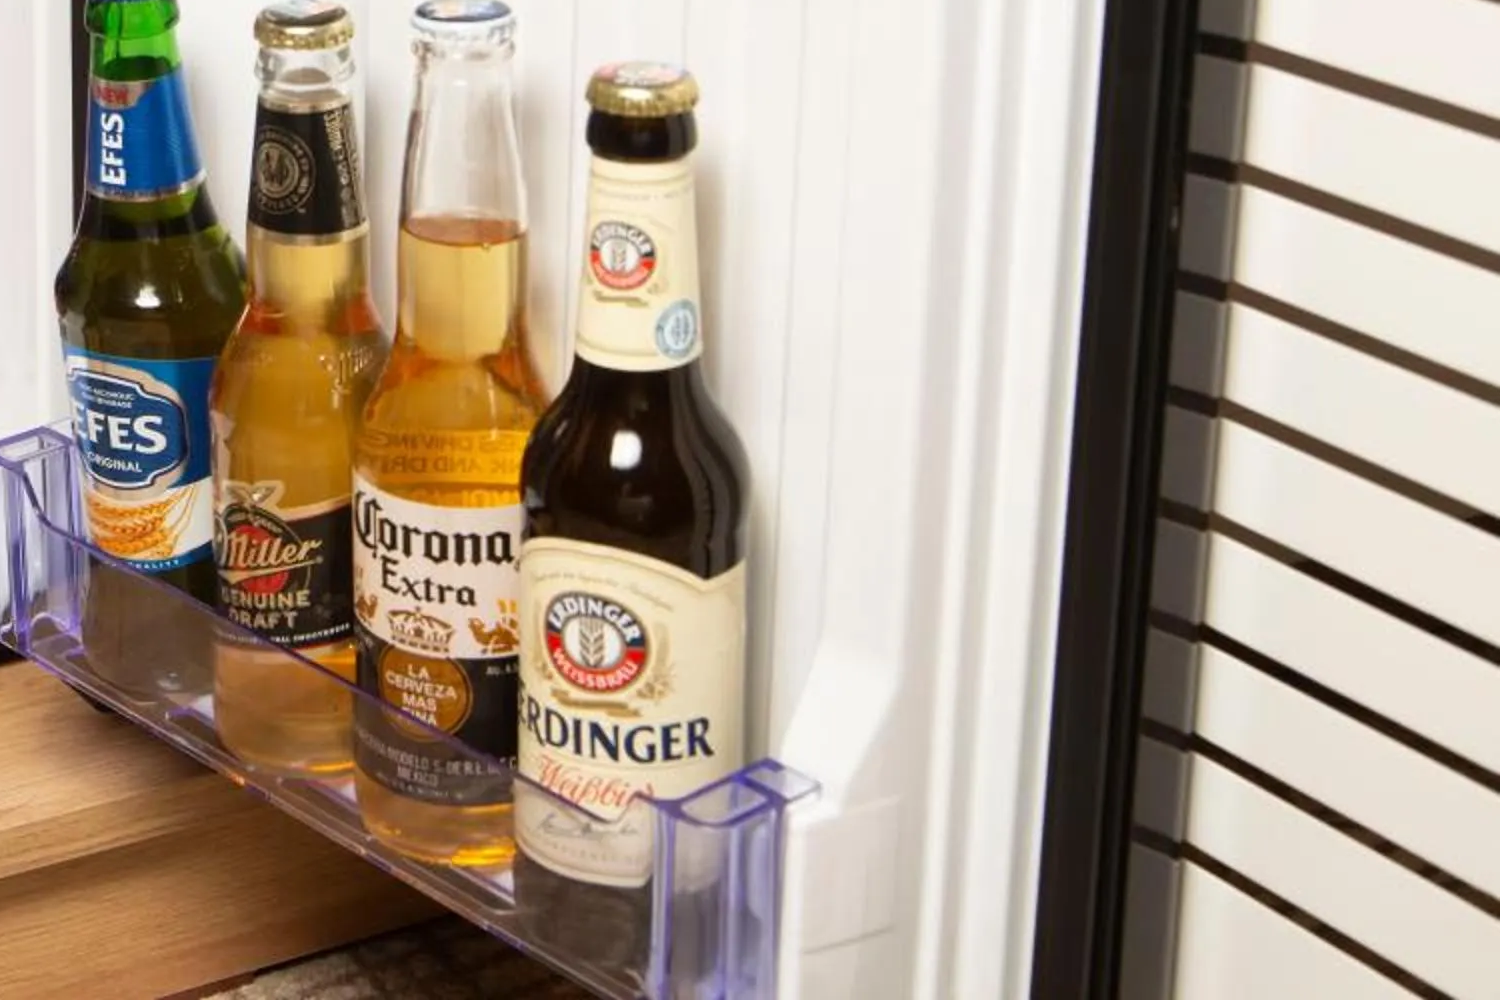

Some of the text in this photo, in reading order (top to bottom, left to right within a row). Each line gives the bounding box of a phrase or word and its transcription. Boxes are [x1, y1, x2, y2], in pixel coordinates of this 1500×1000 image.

[100, 111, 127, 187] EFES
[227, 531, 323, 569] Miller
[355, 490, 516, 566] Corona
[381, 554, 477, 607] Extra
[548, 595, 643, 644] ERDINGER
[385, 670, 458, 700] CERVEZA
[407, 663, 430, 681] LA
